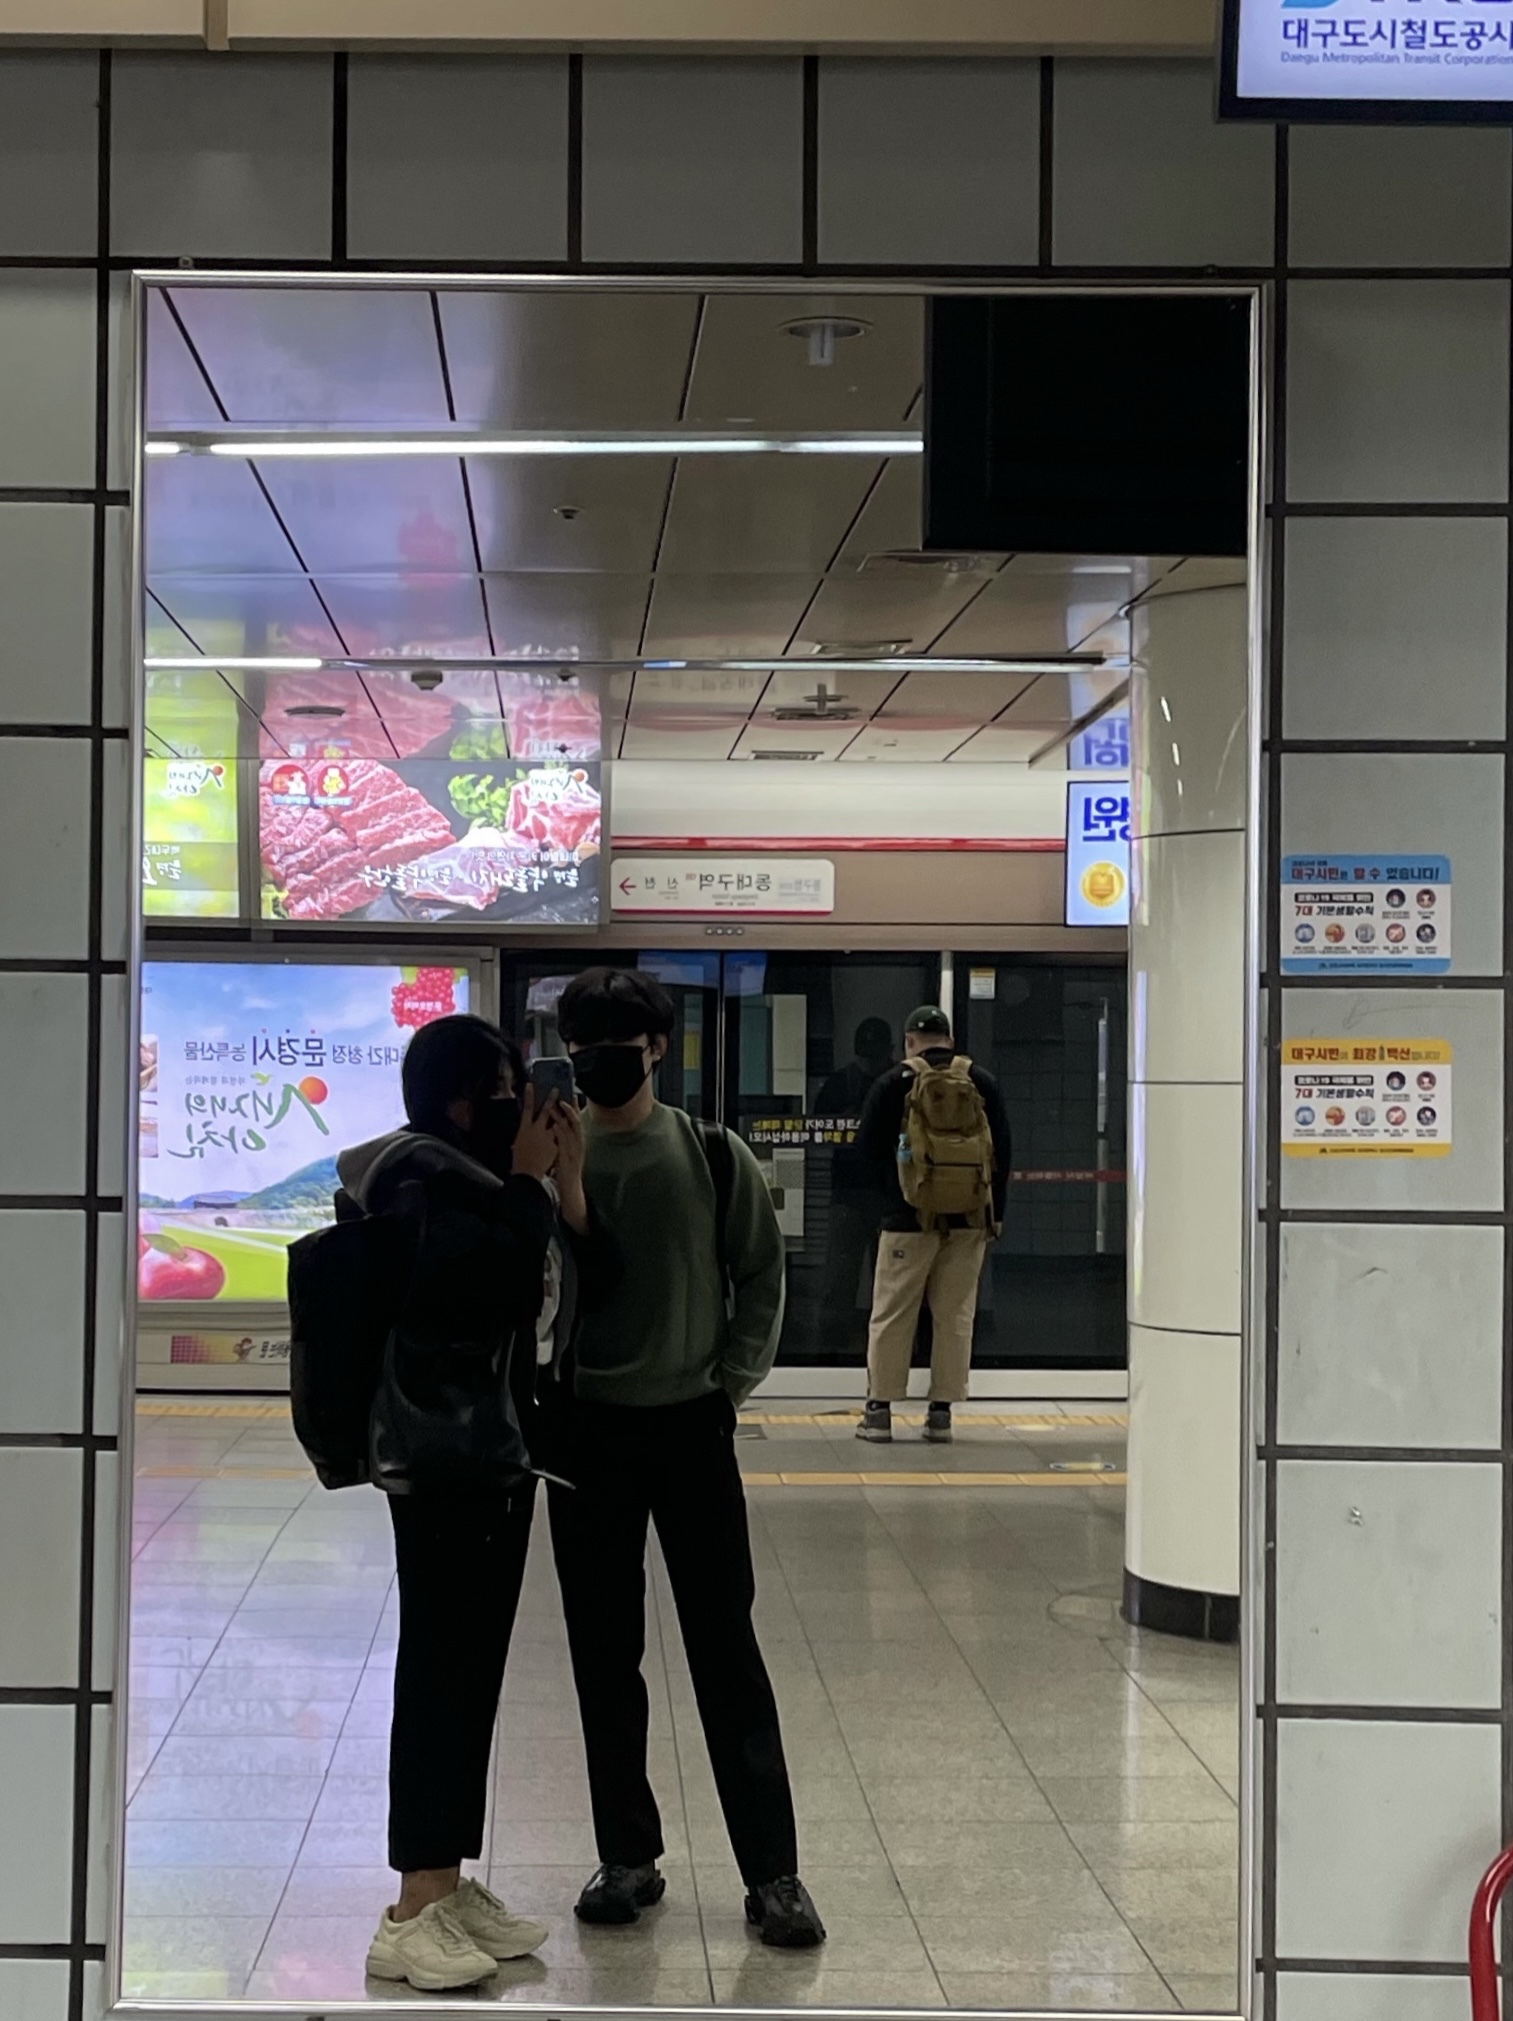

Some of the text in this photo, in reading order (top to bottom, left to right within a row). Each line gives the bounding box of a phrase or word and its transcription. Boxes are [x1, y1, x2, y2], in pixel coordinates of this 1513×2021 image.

[1282, 18, 1513, 51] 대구도시철도공사
[1281, 51, 1513, 67] Daegu Metropolitan Transit Corporation
